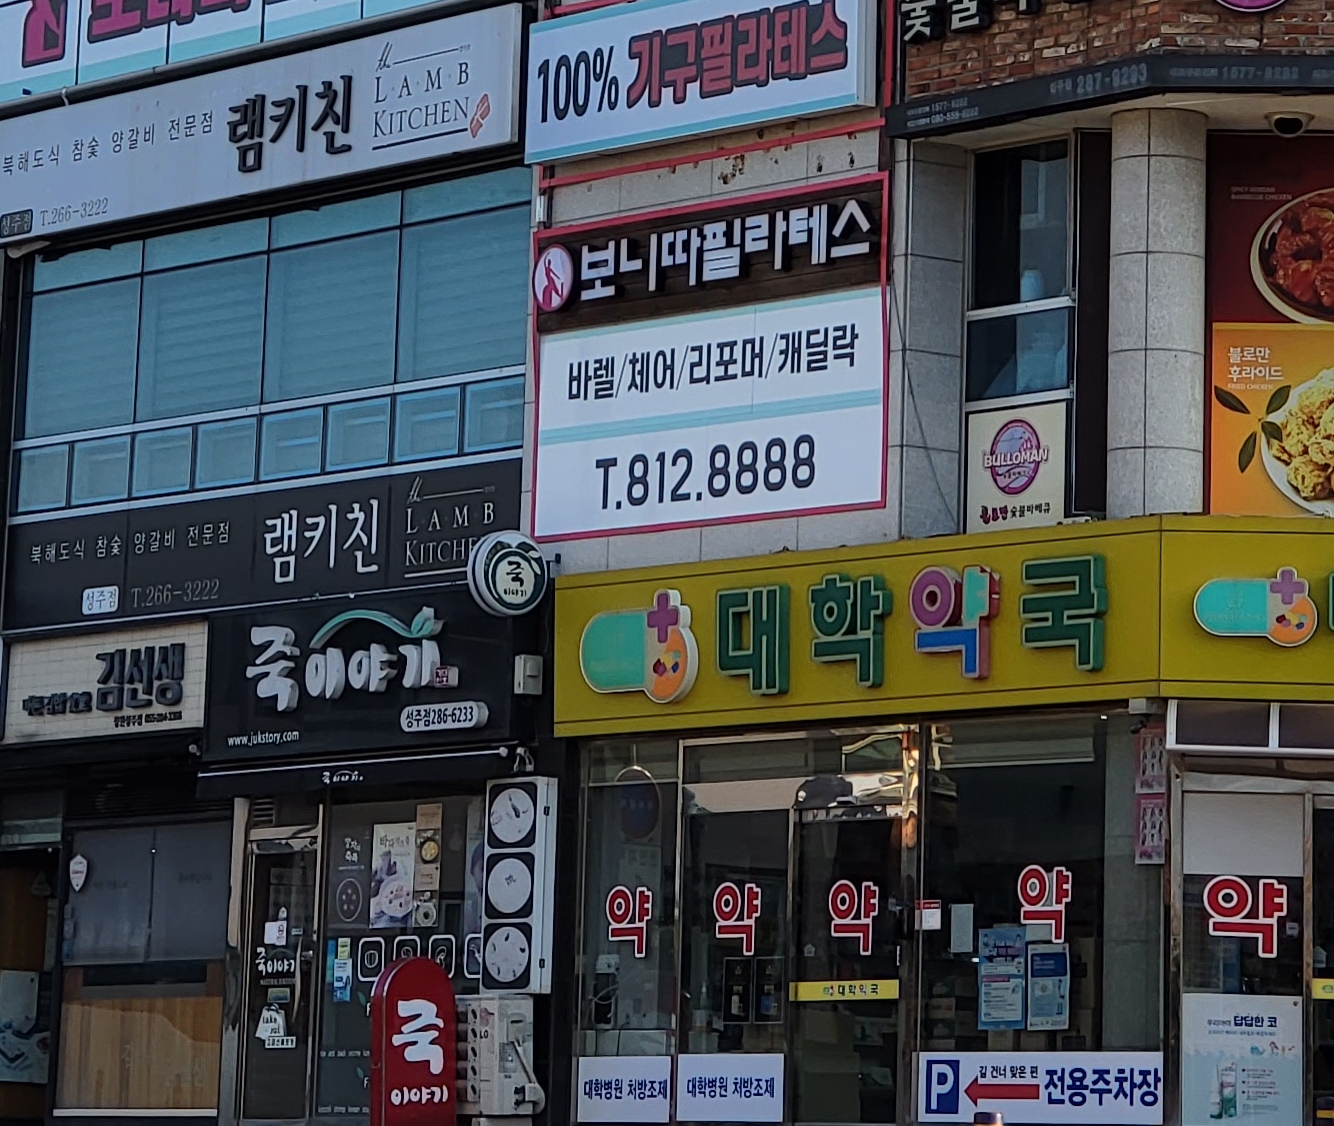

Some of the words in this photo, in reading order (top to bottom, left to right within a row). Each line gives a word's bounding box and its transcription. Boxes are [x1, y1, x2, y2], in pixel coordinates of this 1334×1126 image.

[537, 44, 619, 124] 100%
[2, 145, 60, 177] 북해도식
[71, 135, 99, 163] 참숯
[111, 121, 156, 154] 양갈비
[167, 110, 214, 142] 전문점
[226, 74, 354, 174] 램키친
[371, 95, 471, 139] KITCHEN
[0, 211, 32, 235] 성주점
[39, 196, 109, 227] T.266-3222
[580, 198, 870, 302] 보니따필라테스
[568, 323, 859, 403] 바렐/체어/리포머/캐딜락
[1228, 346, 1271, 363] 불로만
[1228, 365, 1284, 382] 후라이드
[595, 434, 817, 512] T.812.8888
[982, 448, 1050, 469] BULLOMAN
[29, 538, 86, 565] 북해도식
[95, 531, 122, 557] 참숯
[133, 526, 177, 555] 양갈비
[186, 519, 231, 547] 전문점
[263, 497, 380, 584] 램키친
[502, 587, 529, 597] 이야기
[504, 559, 526, 587] 죽
[82, 584, 119, 617] 성주점
[130, 580, 221, 610] T.266-3222
[715, 555, 1109, 696] 대학약국
[96, 641, 187, 713] 김선생
[246, 624, 443, 713] 죽이야기
[227, 730, 301, 748] www.jukstory.com
[606, 884, 653, 959] 약
[713, 882, 762, 957] 약
[829, 879, 880, 956] 약
[1017, 864, 1072, 944] 약
[1203, 875, 1288, 959] 약
[255, 945, 297, 977] 죽이야기
[838, 983, 880, 996] 대학약국
[391, 998, 445, 1076] 죽
[1267, 1016, 1278, 1028] 코
[583, 1078, 625, 1101] 대학병원
[685, 1076, 728, 1099] 대학병원
[731, 1075, 776, 1099] 처방조제
[930, 1063, 959, 1112] P
[990, 1064, 1007, 1079] 건너
[1029, 1065, 1039, 1080] 편
[1044, 1066, 1160, 1108] 전용주차장
[389, 1085, 449, 1106] 이야기
